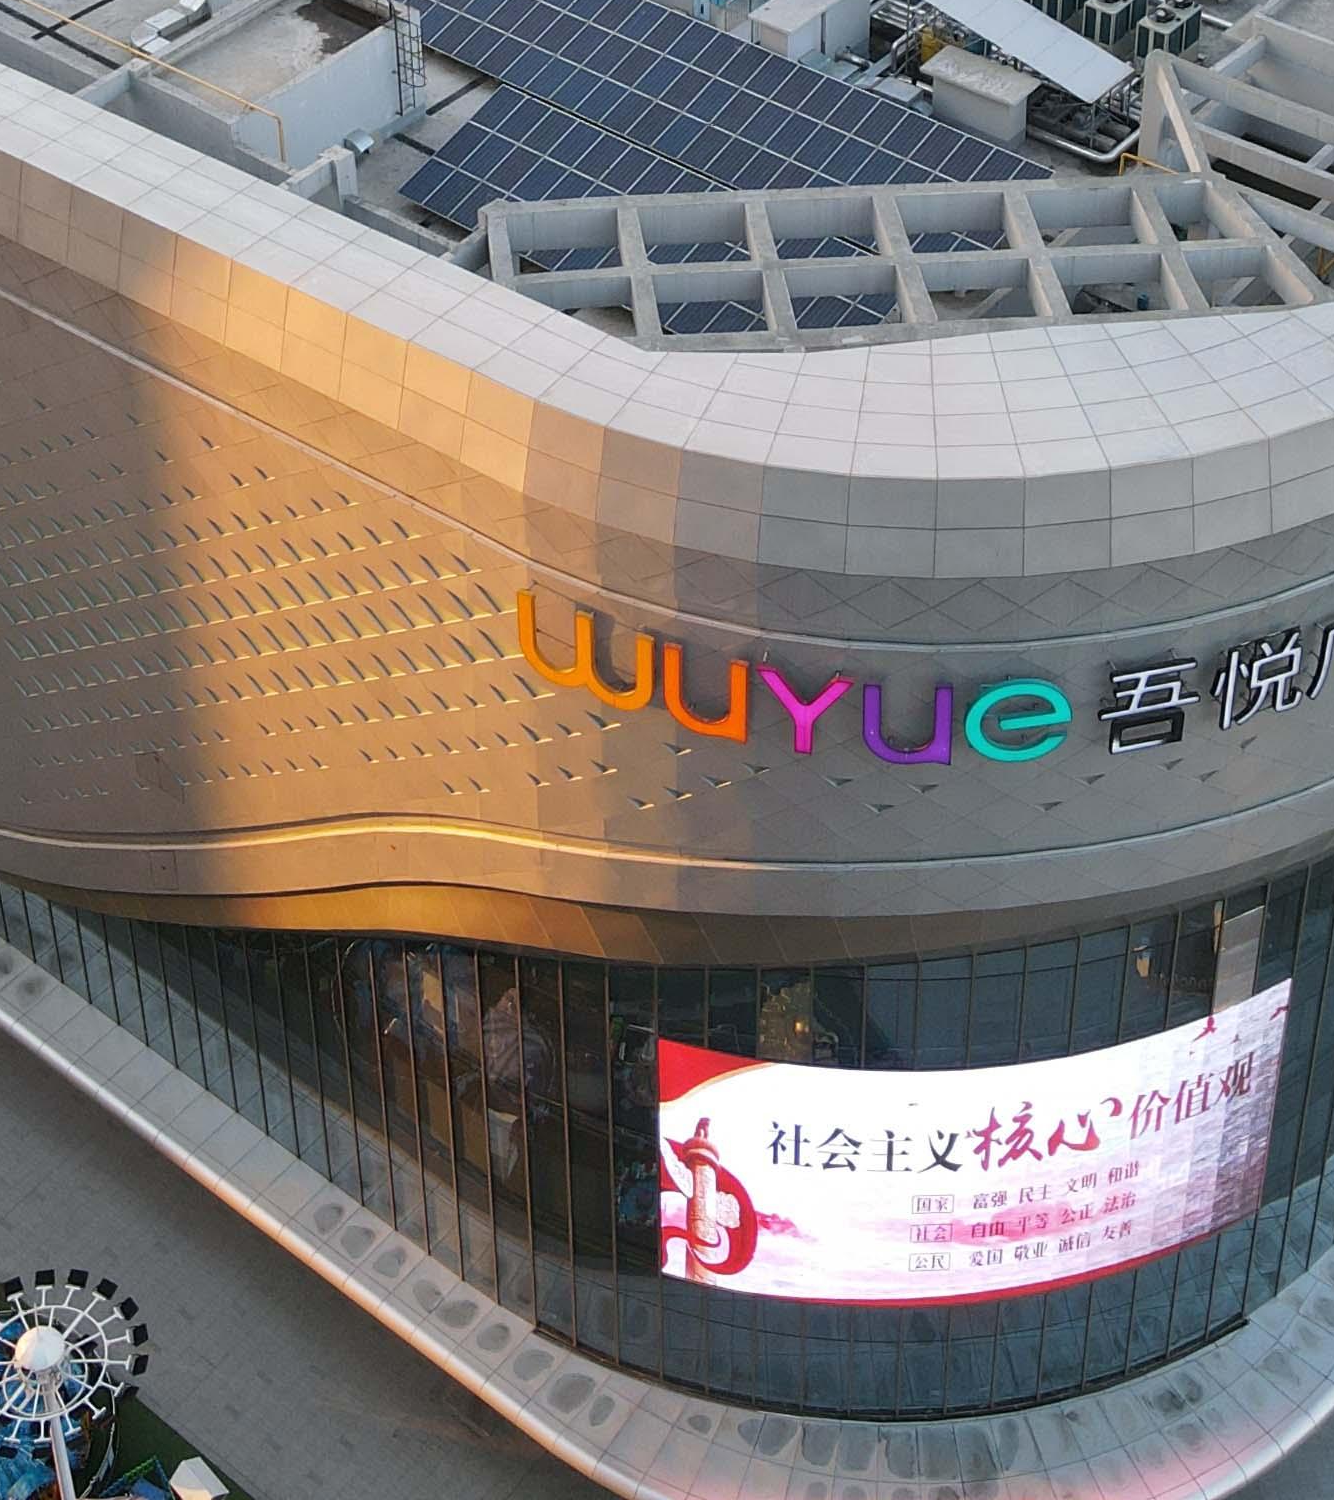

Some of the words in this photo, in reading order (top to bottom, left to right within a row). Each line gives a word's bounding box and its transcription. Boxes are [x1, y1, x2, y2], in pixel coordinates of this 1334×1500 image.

[916, 1196, 949, 1213] 国家
[972, 1190, 1008, 1210] 富强
[1019, 1184, 1052, 1205] 民主
[1067, 1172, 1098, 1193] 文明
[1107, 1160, 1140, 1185] 和谐
[916, 1224, 948, 1242] 社会
[971, 1221, 1005, 1239] 自由
[1018, 1212, 1049, 1234] 平等
[1060, 1203, 1095, 1225] 公正
[1102, 1191, 1136, 1213] 法治
[915, 1254, 945, 1269] 公民
[969, 1248, 1004, 1267] 爱国
[1014, 1241, 1048, 1259] 敬业
[1059, 1231, 1092, 1252] 诚信
[1102, 1219, 1133, 1241] 友善
